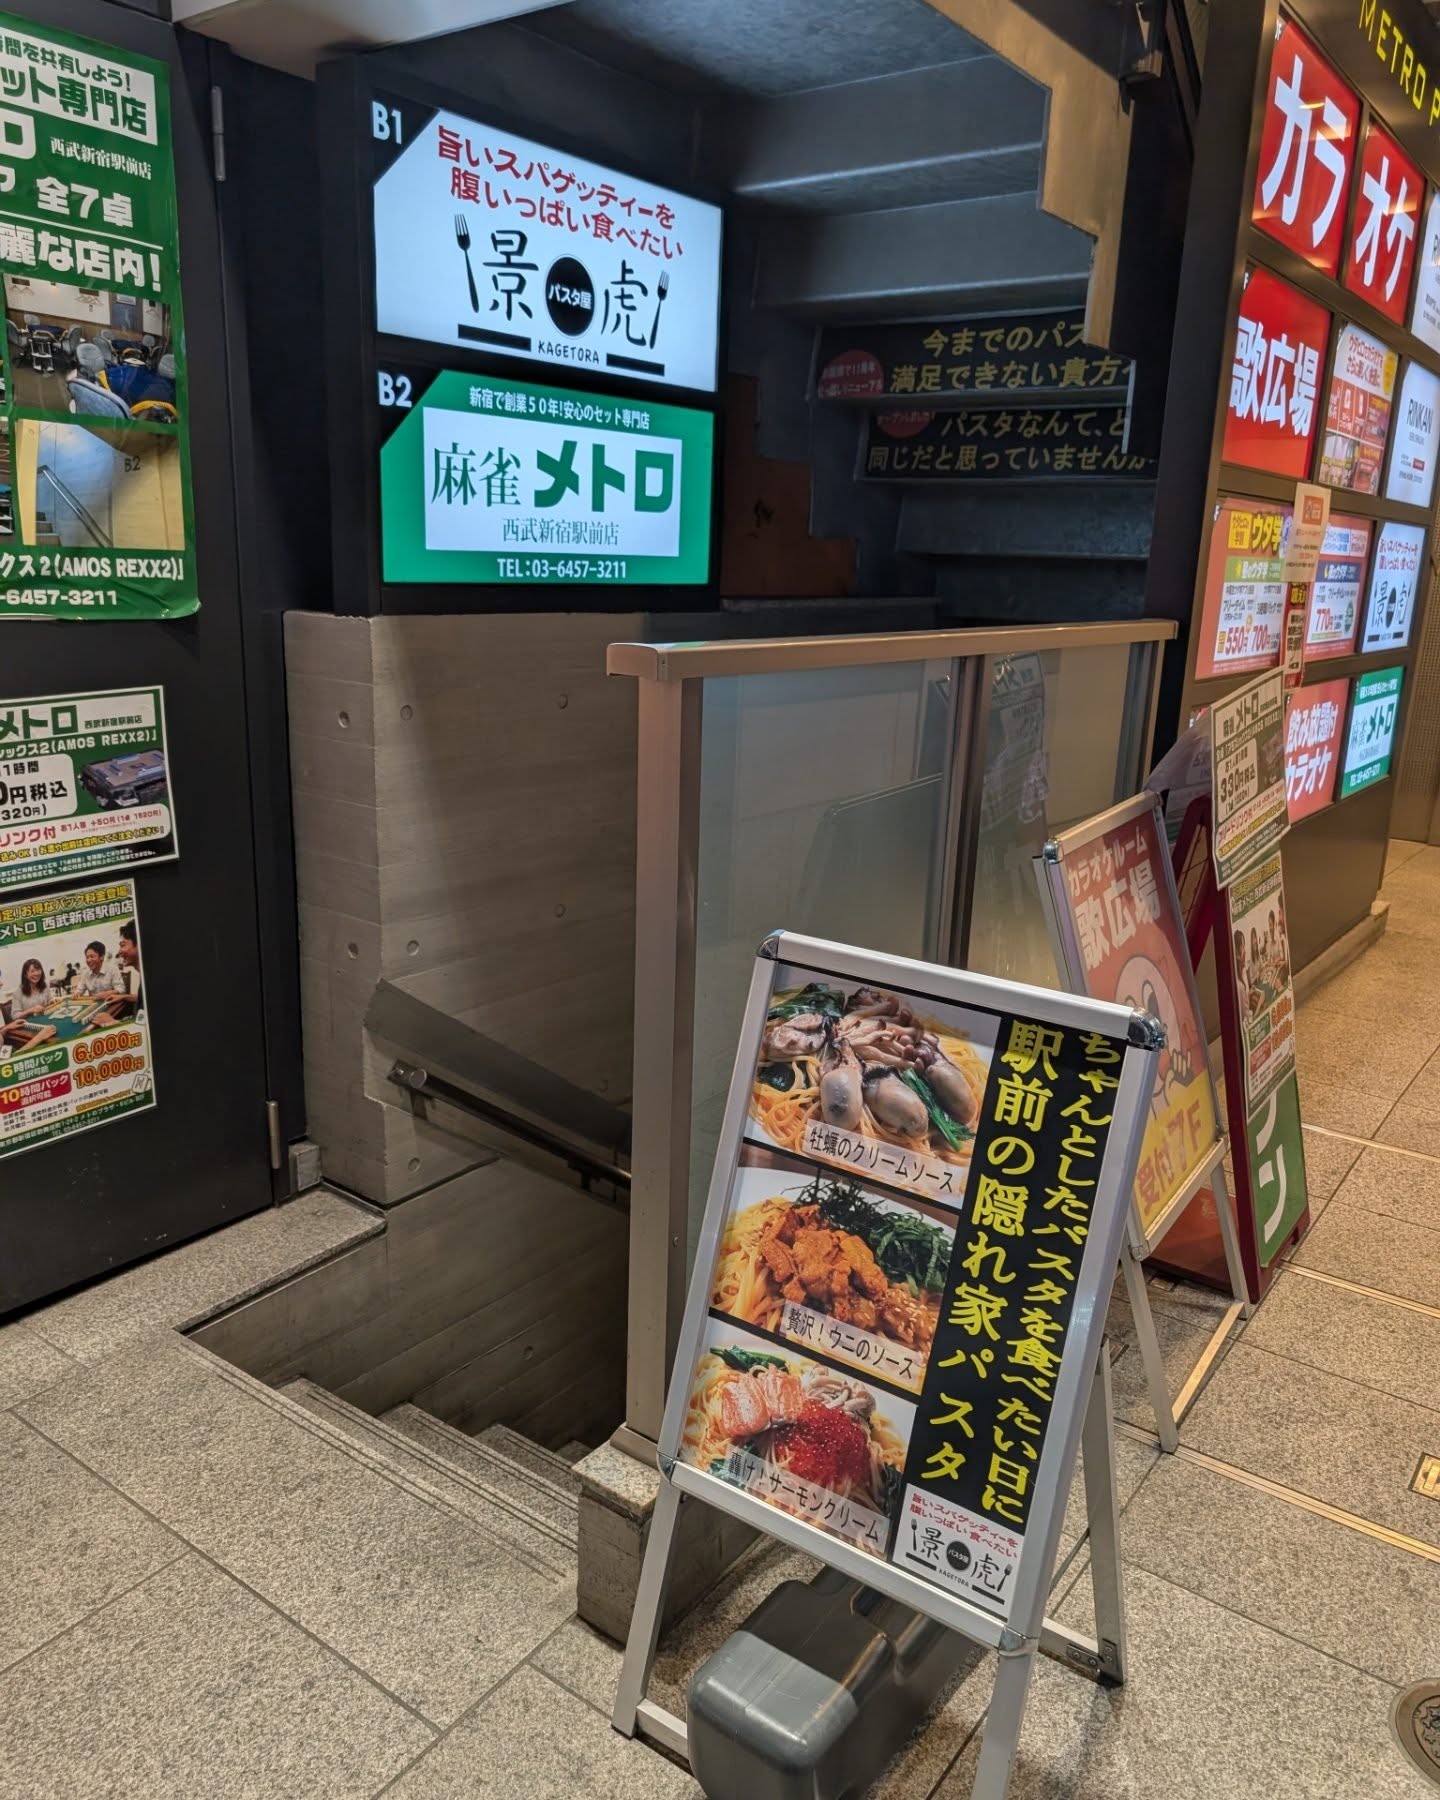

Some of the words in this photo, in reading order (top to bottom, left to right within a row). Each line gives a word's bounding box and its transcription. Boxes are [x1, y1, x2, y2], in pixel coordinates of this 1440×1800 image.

[0, 34, 131, 92] 間を共有しよう！
[1358, 0, 1427, 110] METRO
[0, 65, 147, 137] ット専門店
[372, 101, 402, 144] B1
[50, 136, 152, 181] 西武新宿駅前店
[438, 125, 675, 230] 旨いスパゲッティーを
[36, 176, 133, 228] 全7卓
[450, 166, 683, 260] 腹いっぱい食べたい
[482, 229, 539, 321] 景
[548, 283, 592, 310] パスタ屋
[600, 258, 648, 346] 虎
[538, 341, 600, 364] KAGETORA
[889, 356, 1132, 393] 満足できない貴方
[1230, 315, 1319, 437] 歌広場
[378, 371, 413, 408] B2
[431, 442, 521, 508] 麻雀
[533, 439, 674, 514] メトロ
[502, 518, 620, 546] 西武新宿駅前店
[497, 558, 627, 579] TEL:03-6457-3211
[1068, 826, 1147, 896] カラオケルーム
[42, 900, 133, 931] 西武新宿駅前店
[1075, 858, 1161, 970] 歌広場
[73, 1030, 142, 1064] 6,000円
[74, 1054, 145, 1089] 10,000円
[810, 1126, 954, 1194] 牡蠣のクリームソース
[1136, 1099, 1202, 1216] 受付7F
[920, 1018, 1065, 1480] 駅前の隠れ家パスタ
[981, 1031, 1121, 1524] ちゃんとしたパスタを食べたい日に
[785, 1306, 914, 1380] 贅沢！ウニのソース
[728, 1450, 880, 1544] 轟け！サーモンクリーム
[911, 1493, 1019, 1548] 旨いスパゲッティーを
[910, 1504, 1018, 1558] 腹いっぱい食べたい
[921, 1526, 945, 1560] 景
[970, 1553, 1000, 1589] 虎
[939, 1568, 970, 1587] KAGETORA
